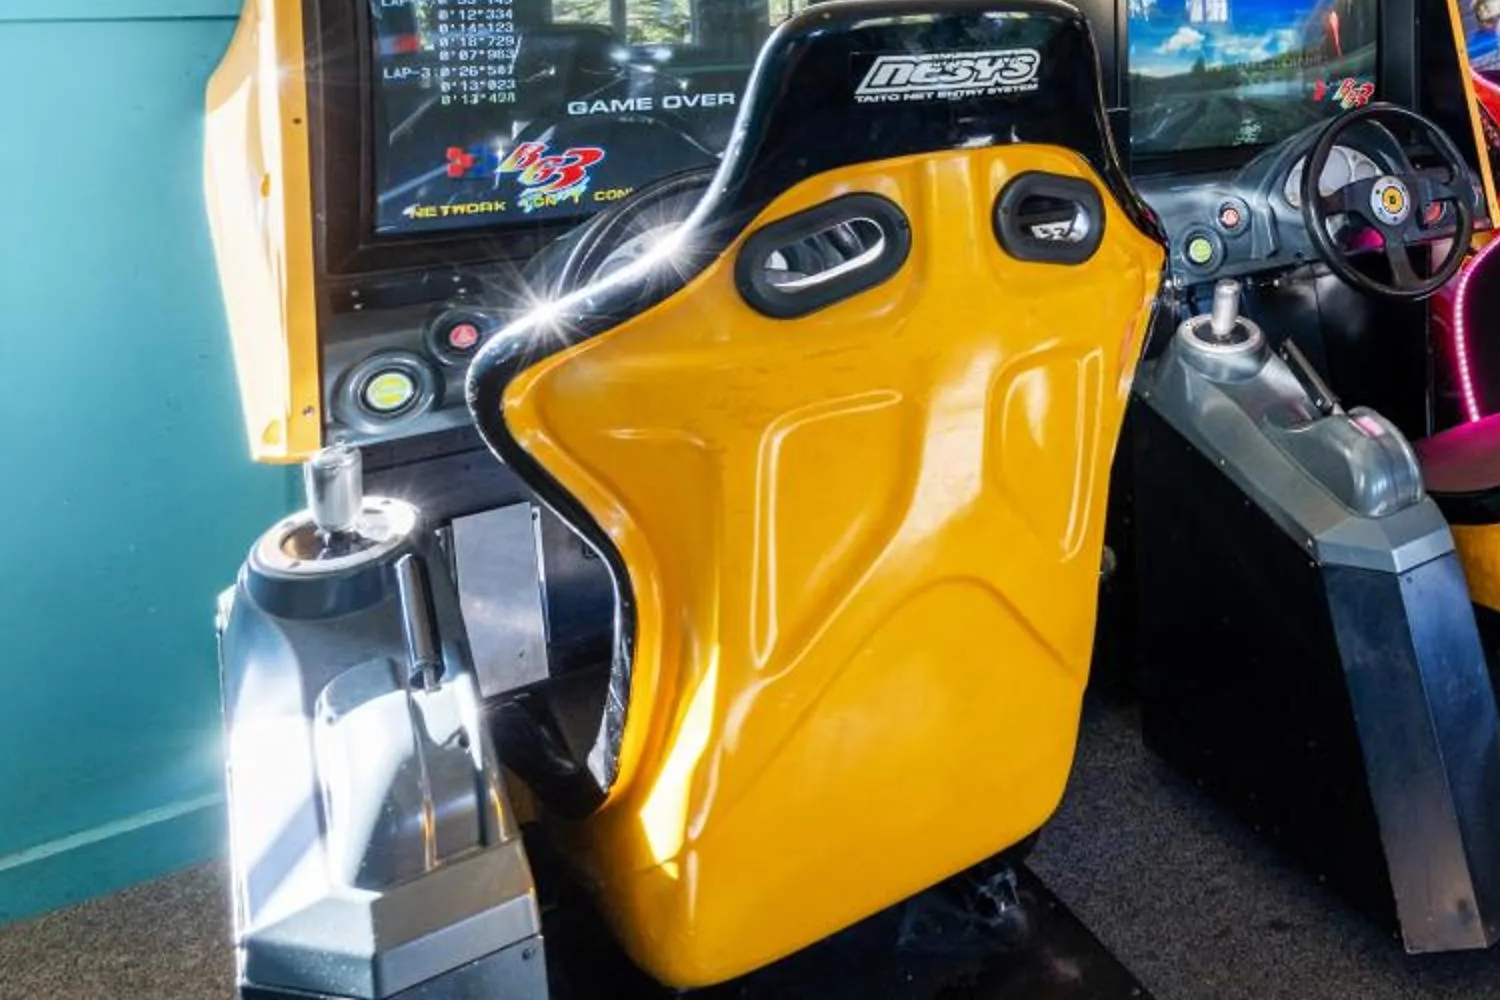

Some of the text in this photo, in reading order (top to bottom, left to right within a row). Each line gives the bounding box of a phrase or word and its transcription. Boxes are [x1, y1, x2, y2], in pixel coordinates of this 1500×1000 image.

[567, 92, 736, 116] GAME OVER
[855, 93, 899, 103] TAITO
[903, 91, 934, 102] NET
